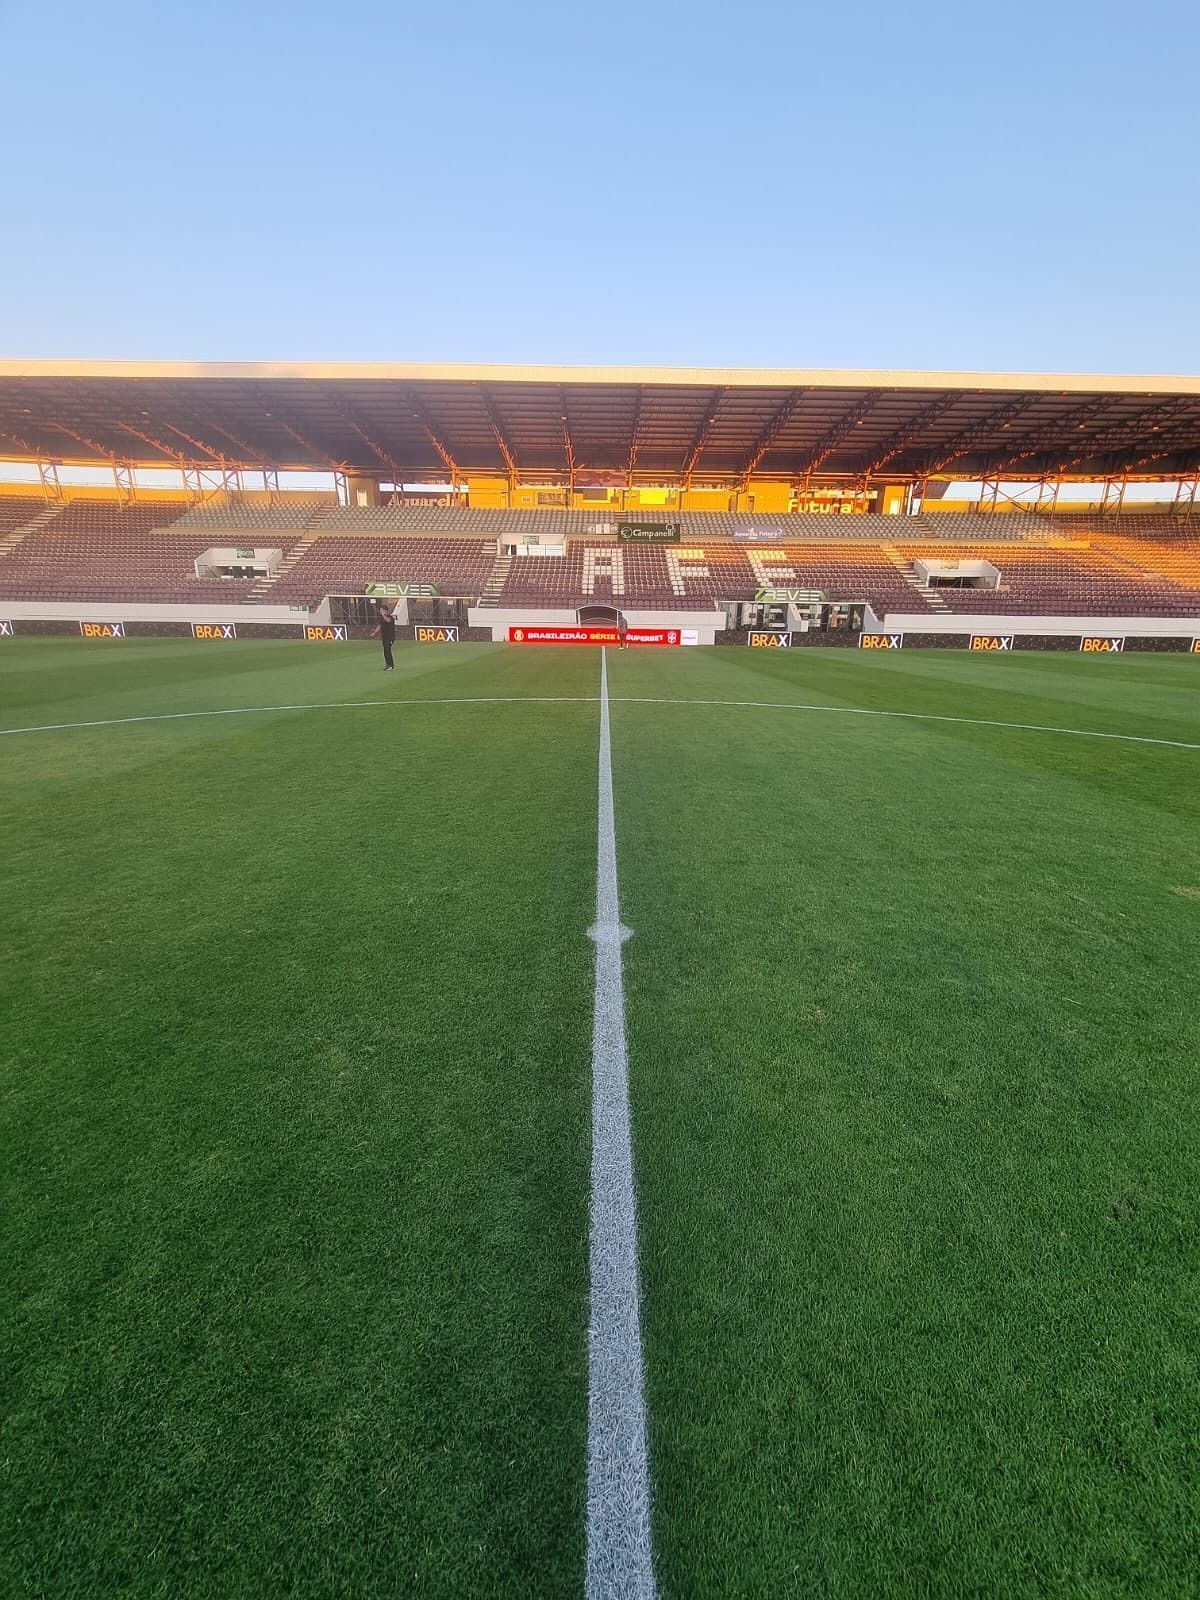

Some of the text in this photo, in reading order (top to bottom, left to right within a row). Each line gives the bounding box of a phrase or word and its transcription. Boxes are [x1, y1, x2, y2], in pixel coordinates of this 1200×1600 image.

[787, 499, 852, 513] Futura
[632, 528, 675, 540] Campanelli
[84, 623, 121, 637] BRAX
[195, 625, 232, 639] BRAX
[307, 627, 344, 640] BRAX
[419, 628, 455, 642] BRAX
[527, 632, 588, 640] BRASILEIRÃO
[626, 634, 664, 642] SUPERBET
[751, 634, 788, 647] BRAX
[863, 635, 899, 649] BRAX
[973, 637, 1010, 650] BRAX
[1084, 638, 1120, 652] BRAX
